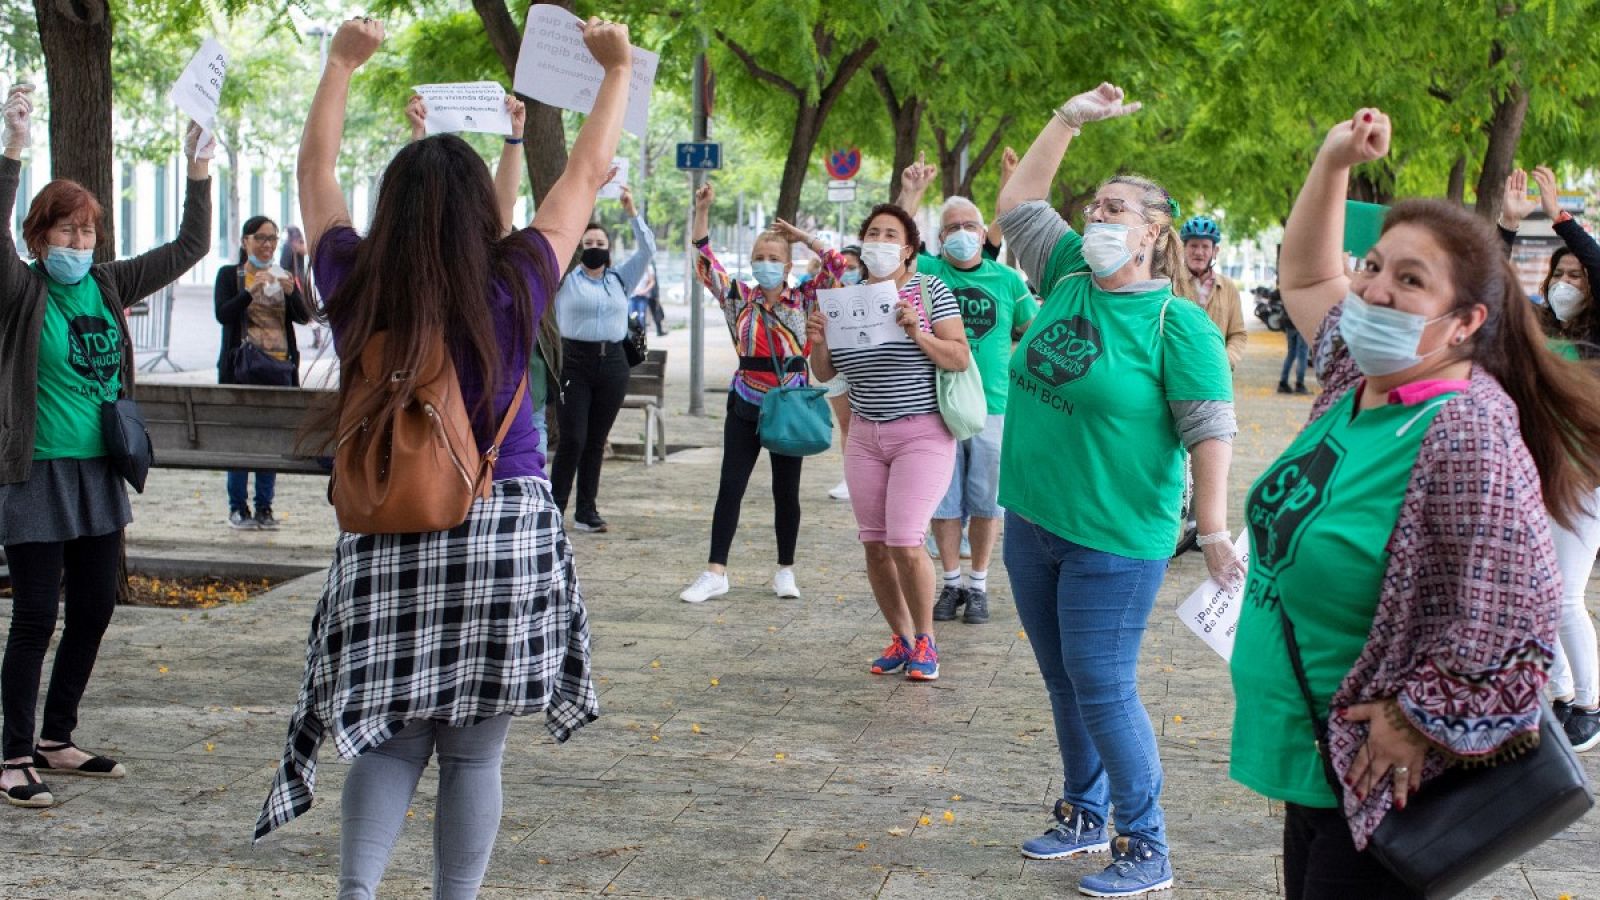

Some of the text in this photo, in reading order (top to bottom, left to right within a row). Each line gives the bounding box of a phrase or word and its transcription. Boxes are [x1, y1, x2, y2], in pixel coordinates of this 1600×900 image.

[957, 294, 992, 317] TOP
[1030, 338, 1085, 375] DESAHUCIOS
[1043, 322, 1098, 362] STOP
[1009, 368, 1075, 417] PAH BCN
[1194, 586, 1226, 626] ¡Parem
